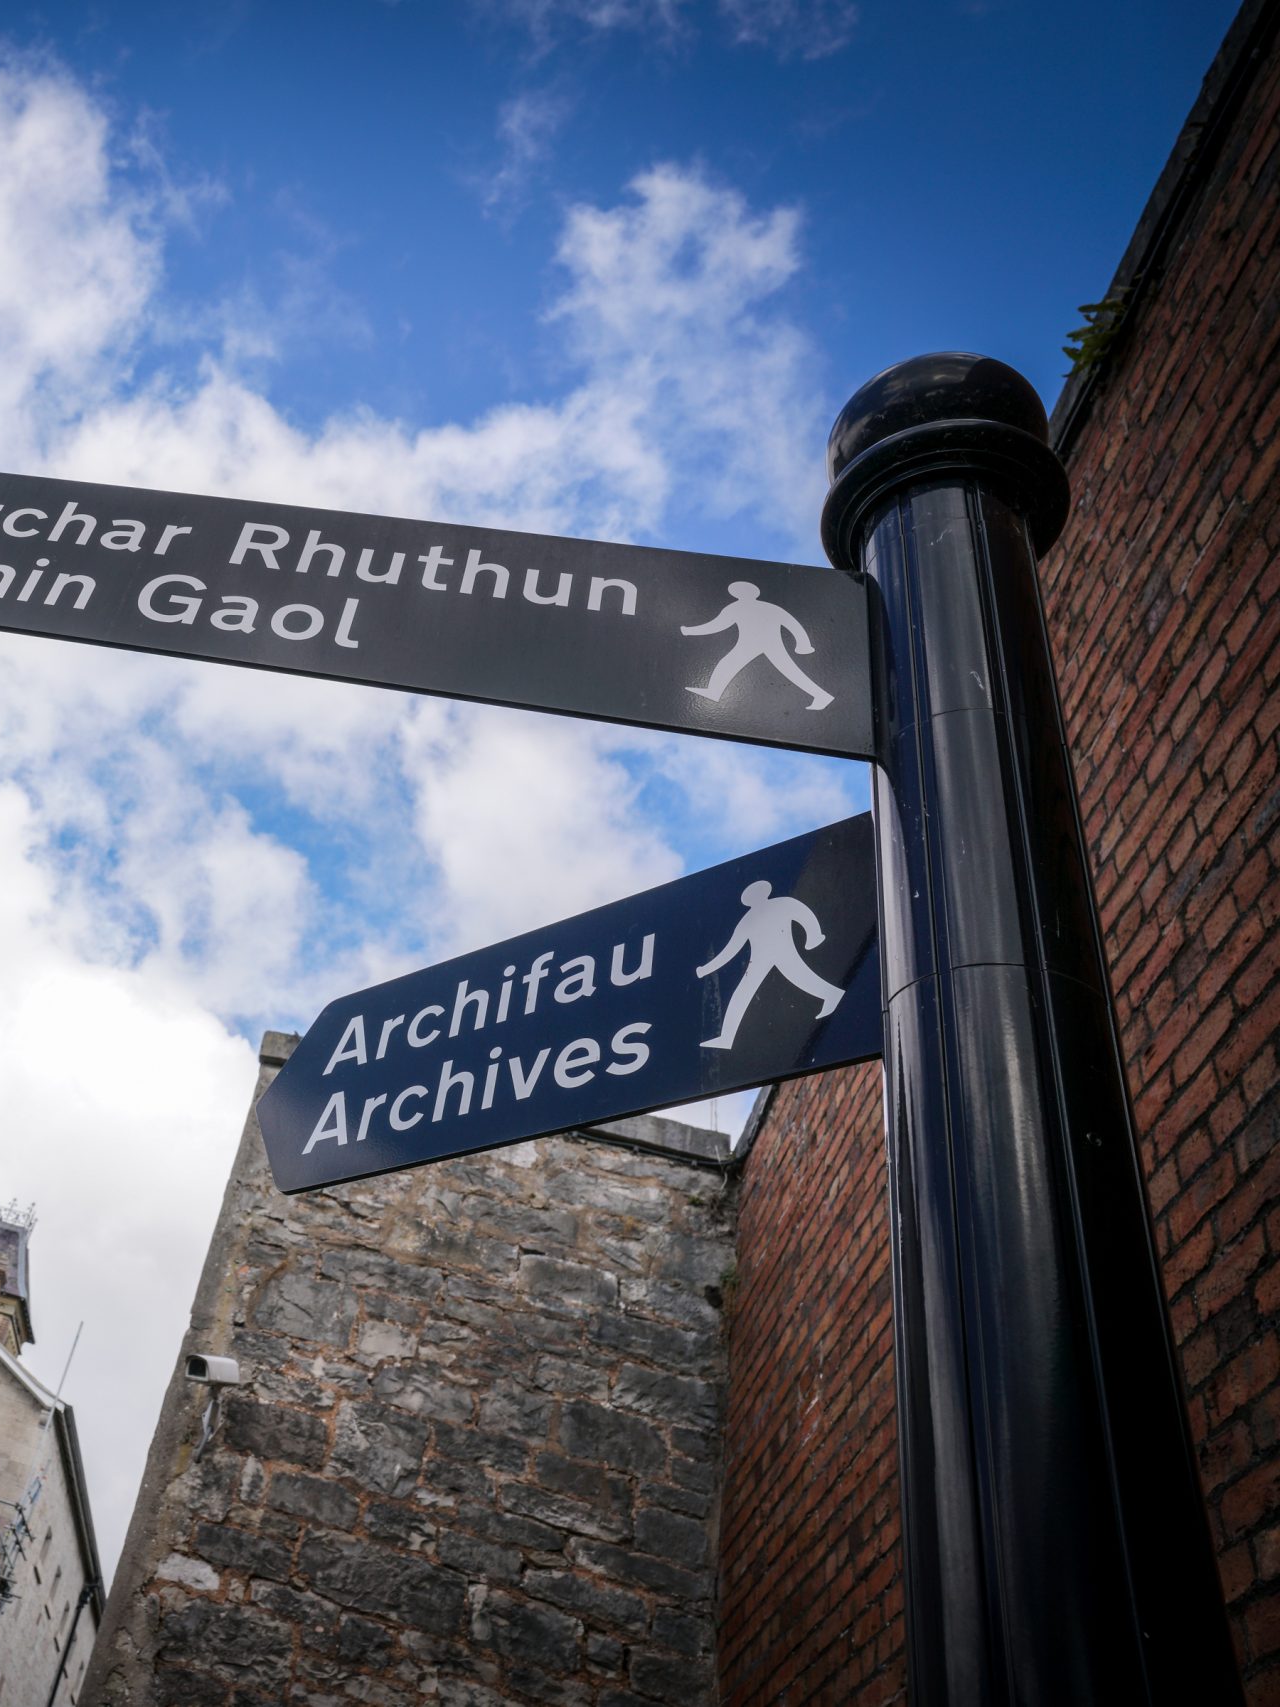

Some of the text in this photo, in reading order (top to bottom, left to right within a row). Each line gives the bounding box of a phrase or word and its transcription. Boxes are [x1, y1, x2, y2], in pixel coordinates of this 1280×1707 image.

[137, 574, 359, 649] Gaol
[227, 522, 638, 616] Rhuthun
[322, 933, 656, 1076] Archifau
[302, 1022, 652, 1156] Archives
